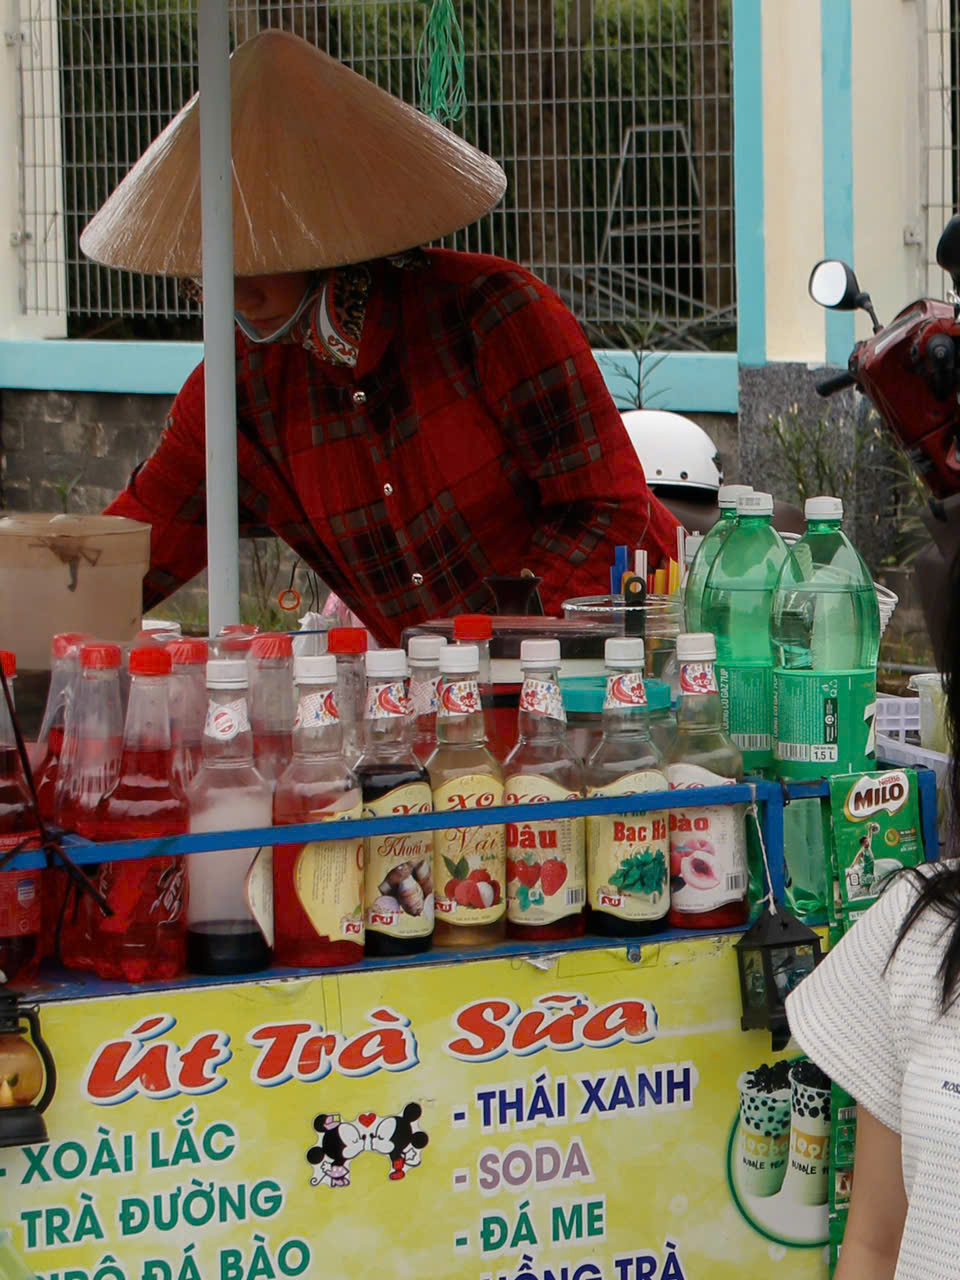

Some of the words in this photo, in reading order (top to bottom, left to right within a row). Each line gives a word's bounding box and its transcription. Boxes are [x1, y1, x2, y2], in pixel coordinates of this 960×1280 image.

[829, 751, 836, 760] L
[854, 783, 904, 811] MILO
[507, 823, 557, 848] Dâu
[613, 821, 647, 847] Bạc
[86, 1015, 226, 1102] Út
[250, 1009, 412, 1081] Trà
[448, 994, 655, 1056] Sữa
[478, 1074, 566, 1127] THÁI
[581, 1068, 691, 1113] XANH
[21, 1126, 133, 1184] XOÀI
[151, 1107, 236, 1167] LẮC
[479, 1142, 589, 1191] SODA
[21, 1193, 104, 1249] TRÀ
[120, 1179, 283, 1235] ĐƯỜNG
[480, 1201, 537, 1252] ĐÁ
[552, 1201, 605, 1242] ME
